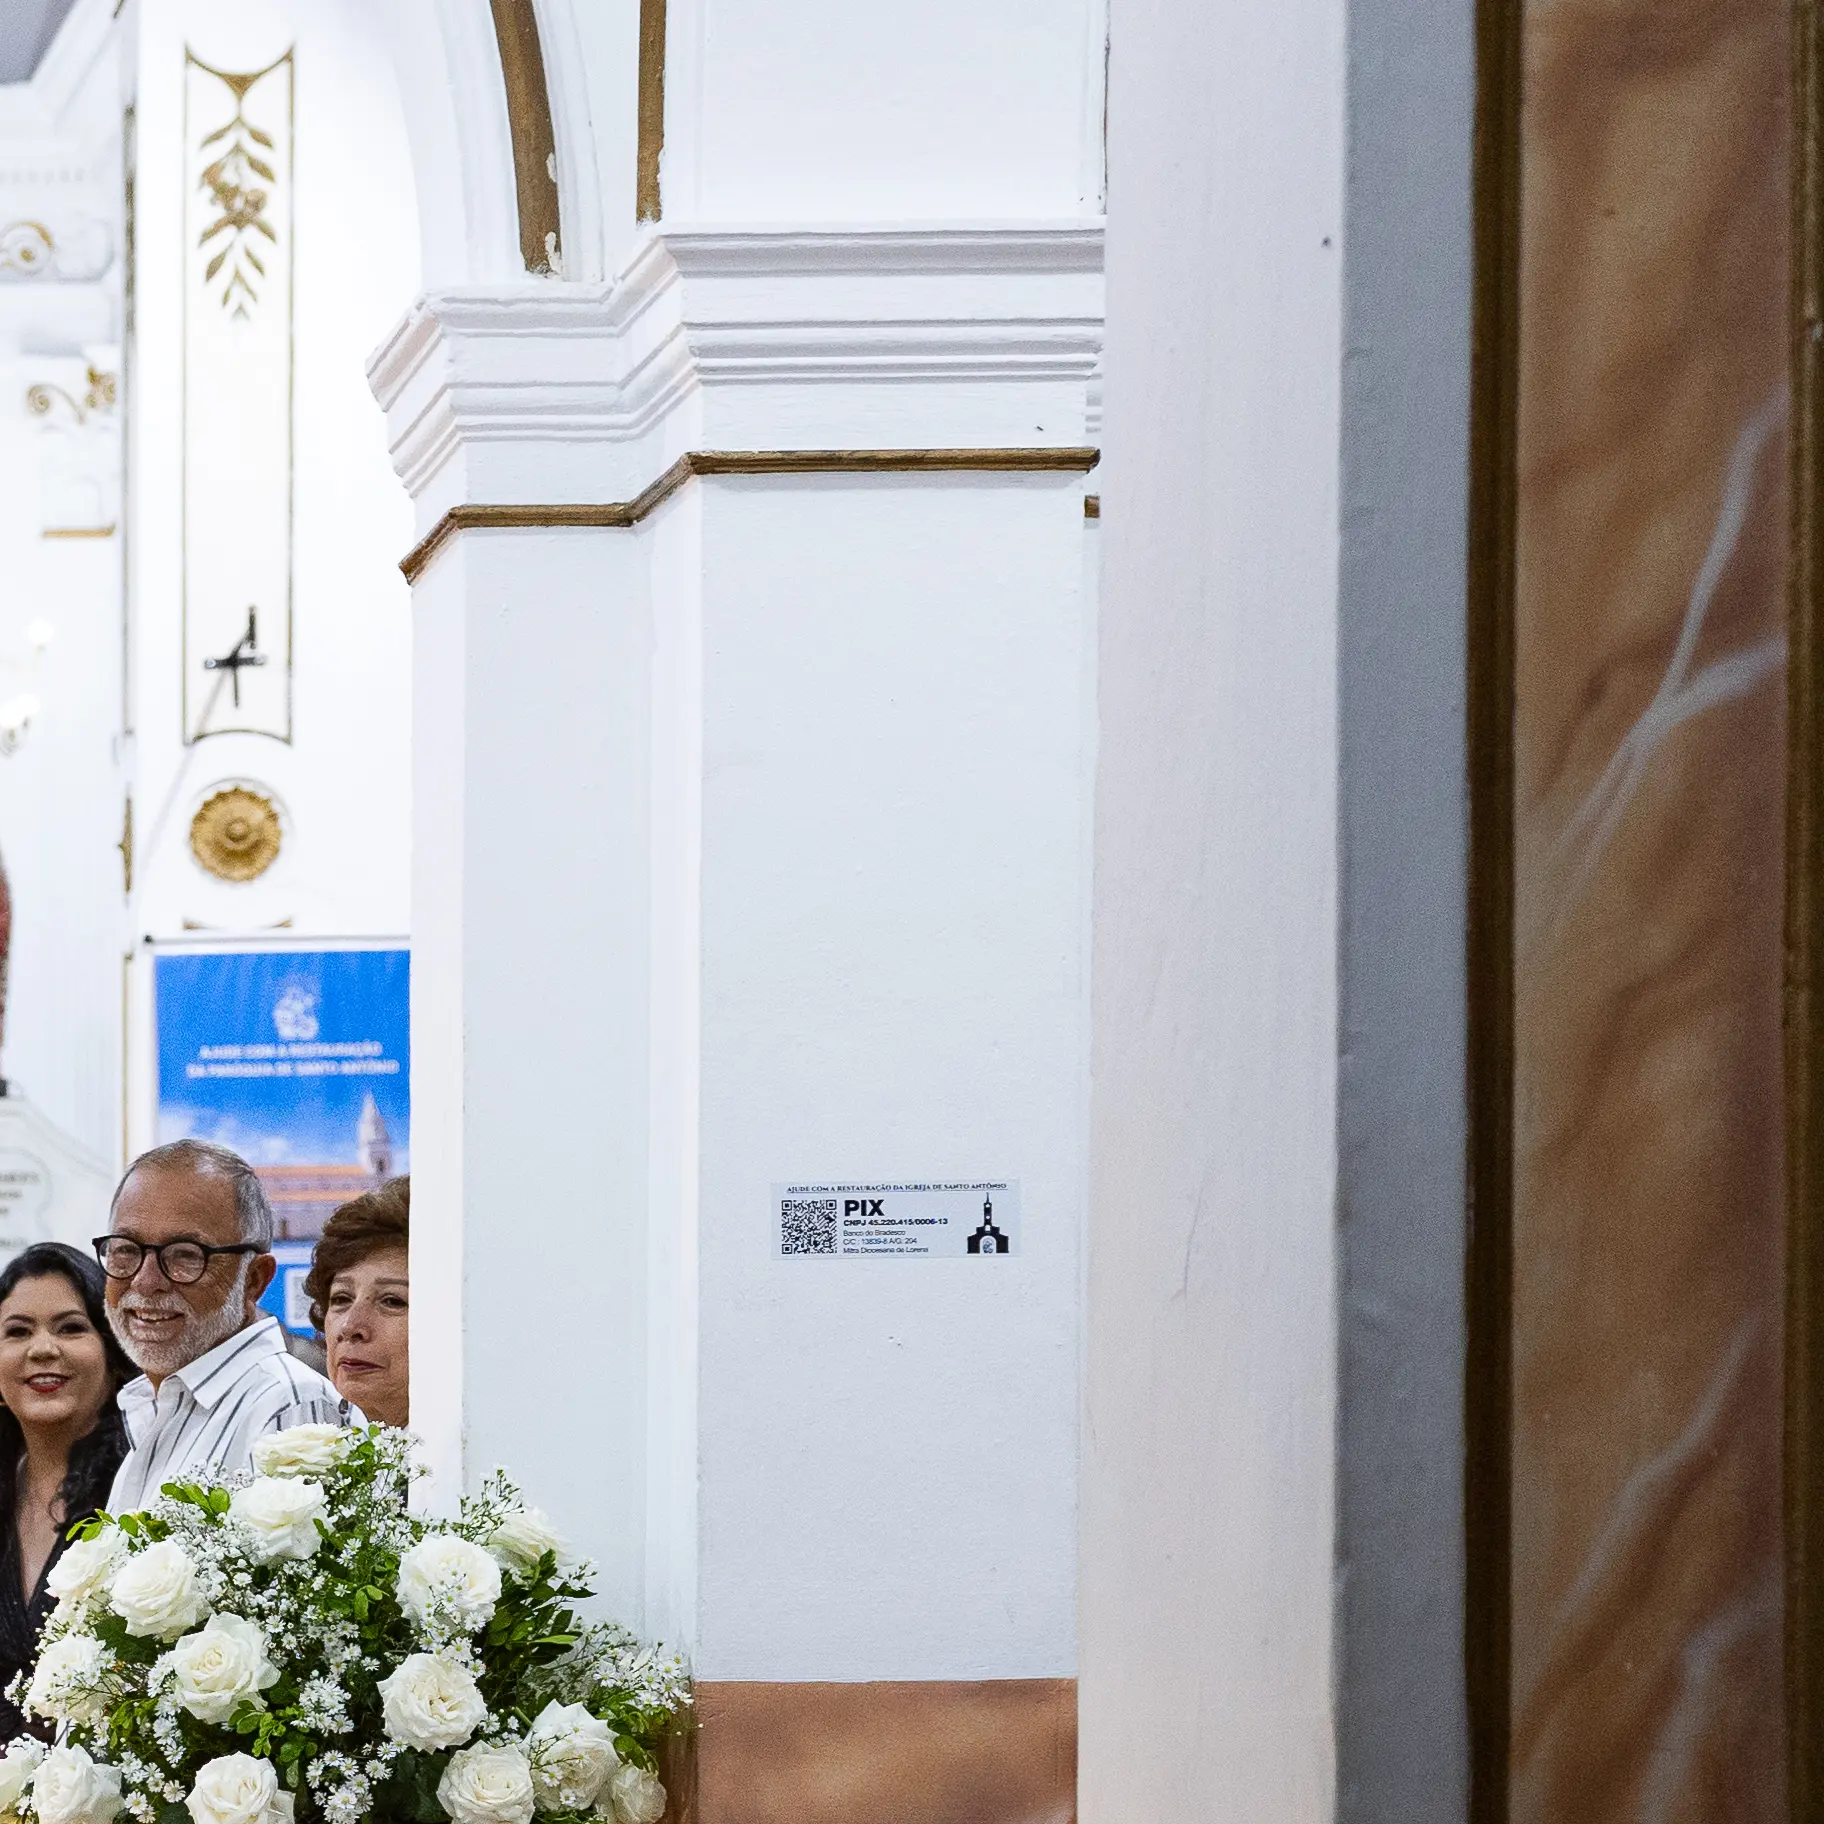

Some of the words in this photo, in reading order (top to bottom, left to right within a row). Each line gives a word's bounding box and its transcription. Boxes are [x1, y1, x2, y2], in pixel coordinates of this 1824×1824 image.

[787, 1186, 810, 1194] AJUDE
[904, 1184, 932, 1192] IGREJA
[844, 1199, 885, 1217] PIX
[843, 1219, 866, 1227] CNPJ
